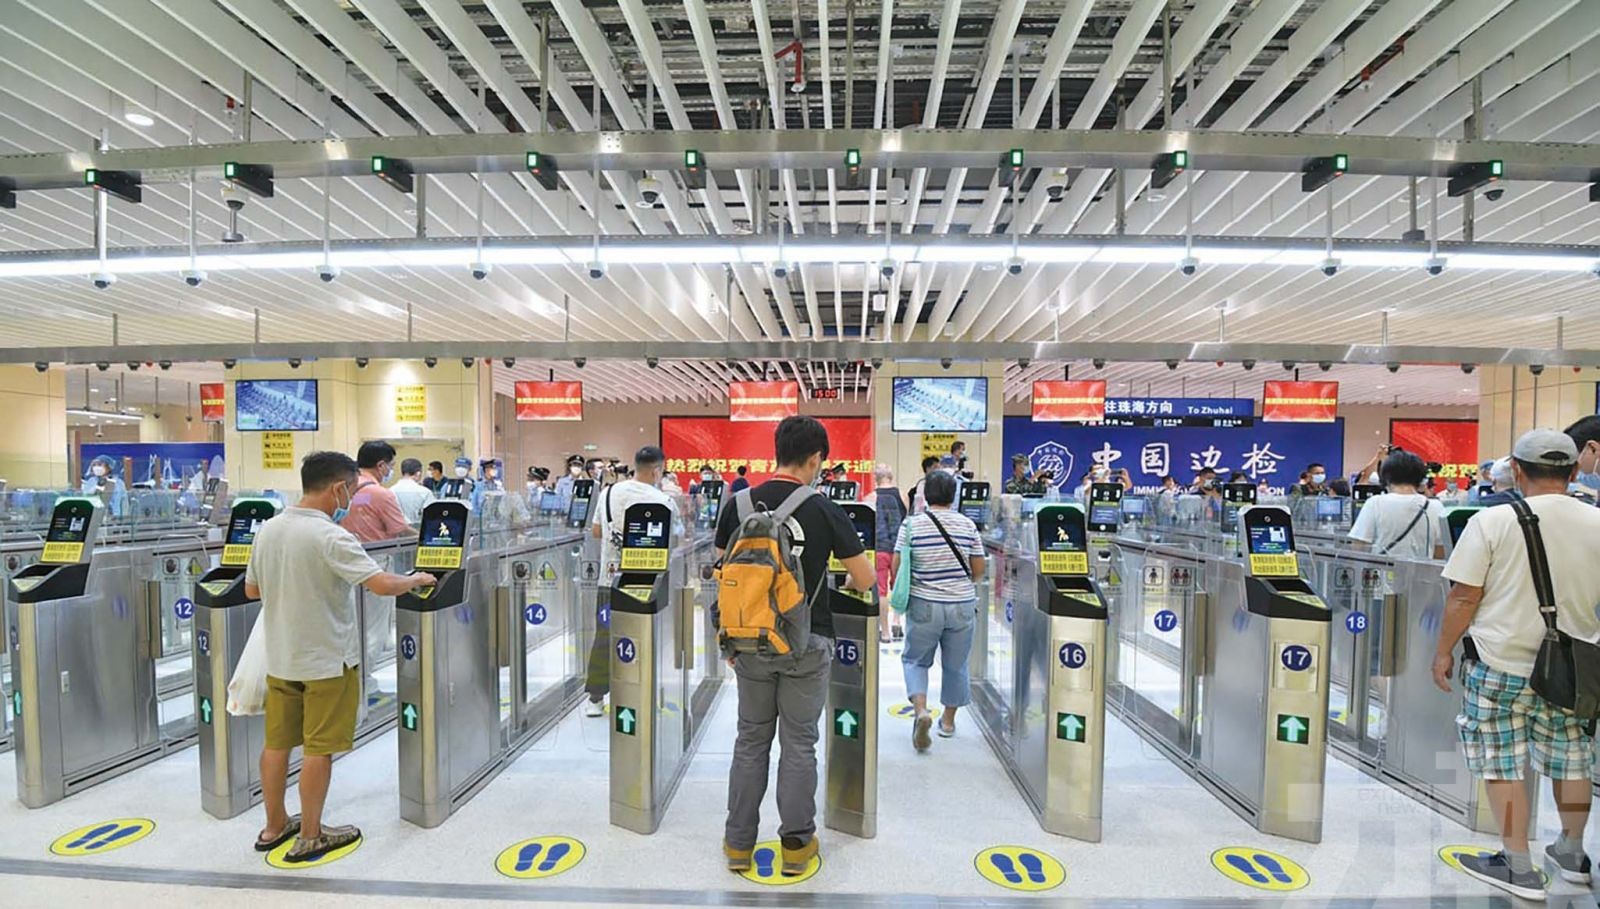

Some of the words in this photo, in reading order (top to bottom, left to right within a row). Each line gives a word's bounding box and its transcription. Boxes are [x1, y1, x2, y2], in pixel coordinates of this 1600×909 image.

[1104, 401, 1173, 414] 往珠海方向
[1187, 406, 1200, 415] To
[1201, 406, 1233, 415] Zhuhai
[1092, 442, 1286, 479] 中国边检
[176, 602, 192, 615] 12
[526, 608, 545, 621] 14
[1156, 614, 1174, 628] 17
[1347, 616, 1366, 629] 18
[198, 635, 208, 650] 12
[403, 639, 414, 655] 13
[617, 642, 634, 659] 14
[838, 644, 857, 661] 15
[1061, 647, 1085, 664] 16
[1283, 649, 1309, 666] 17
